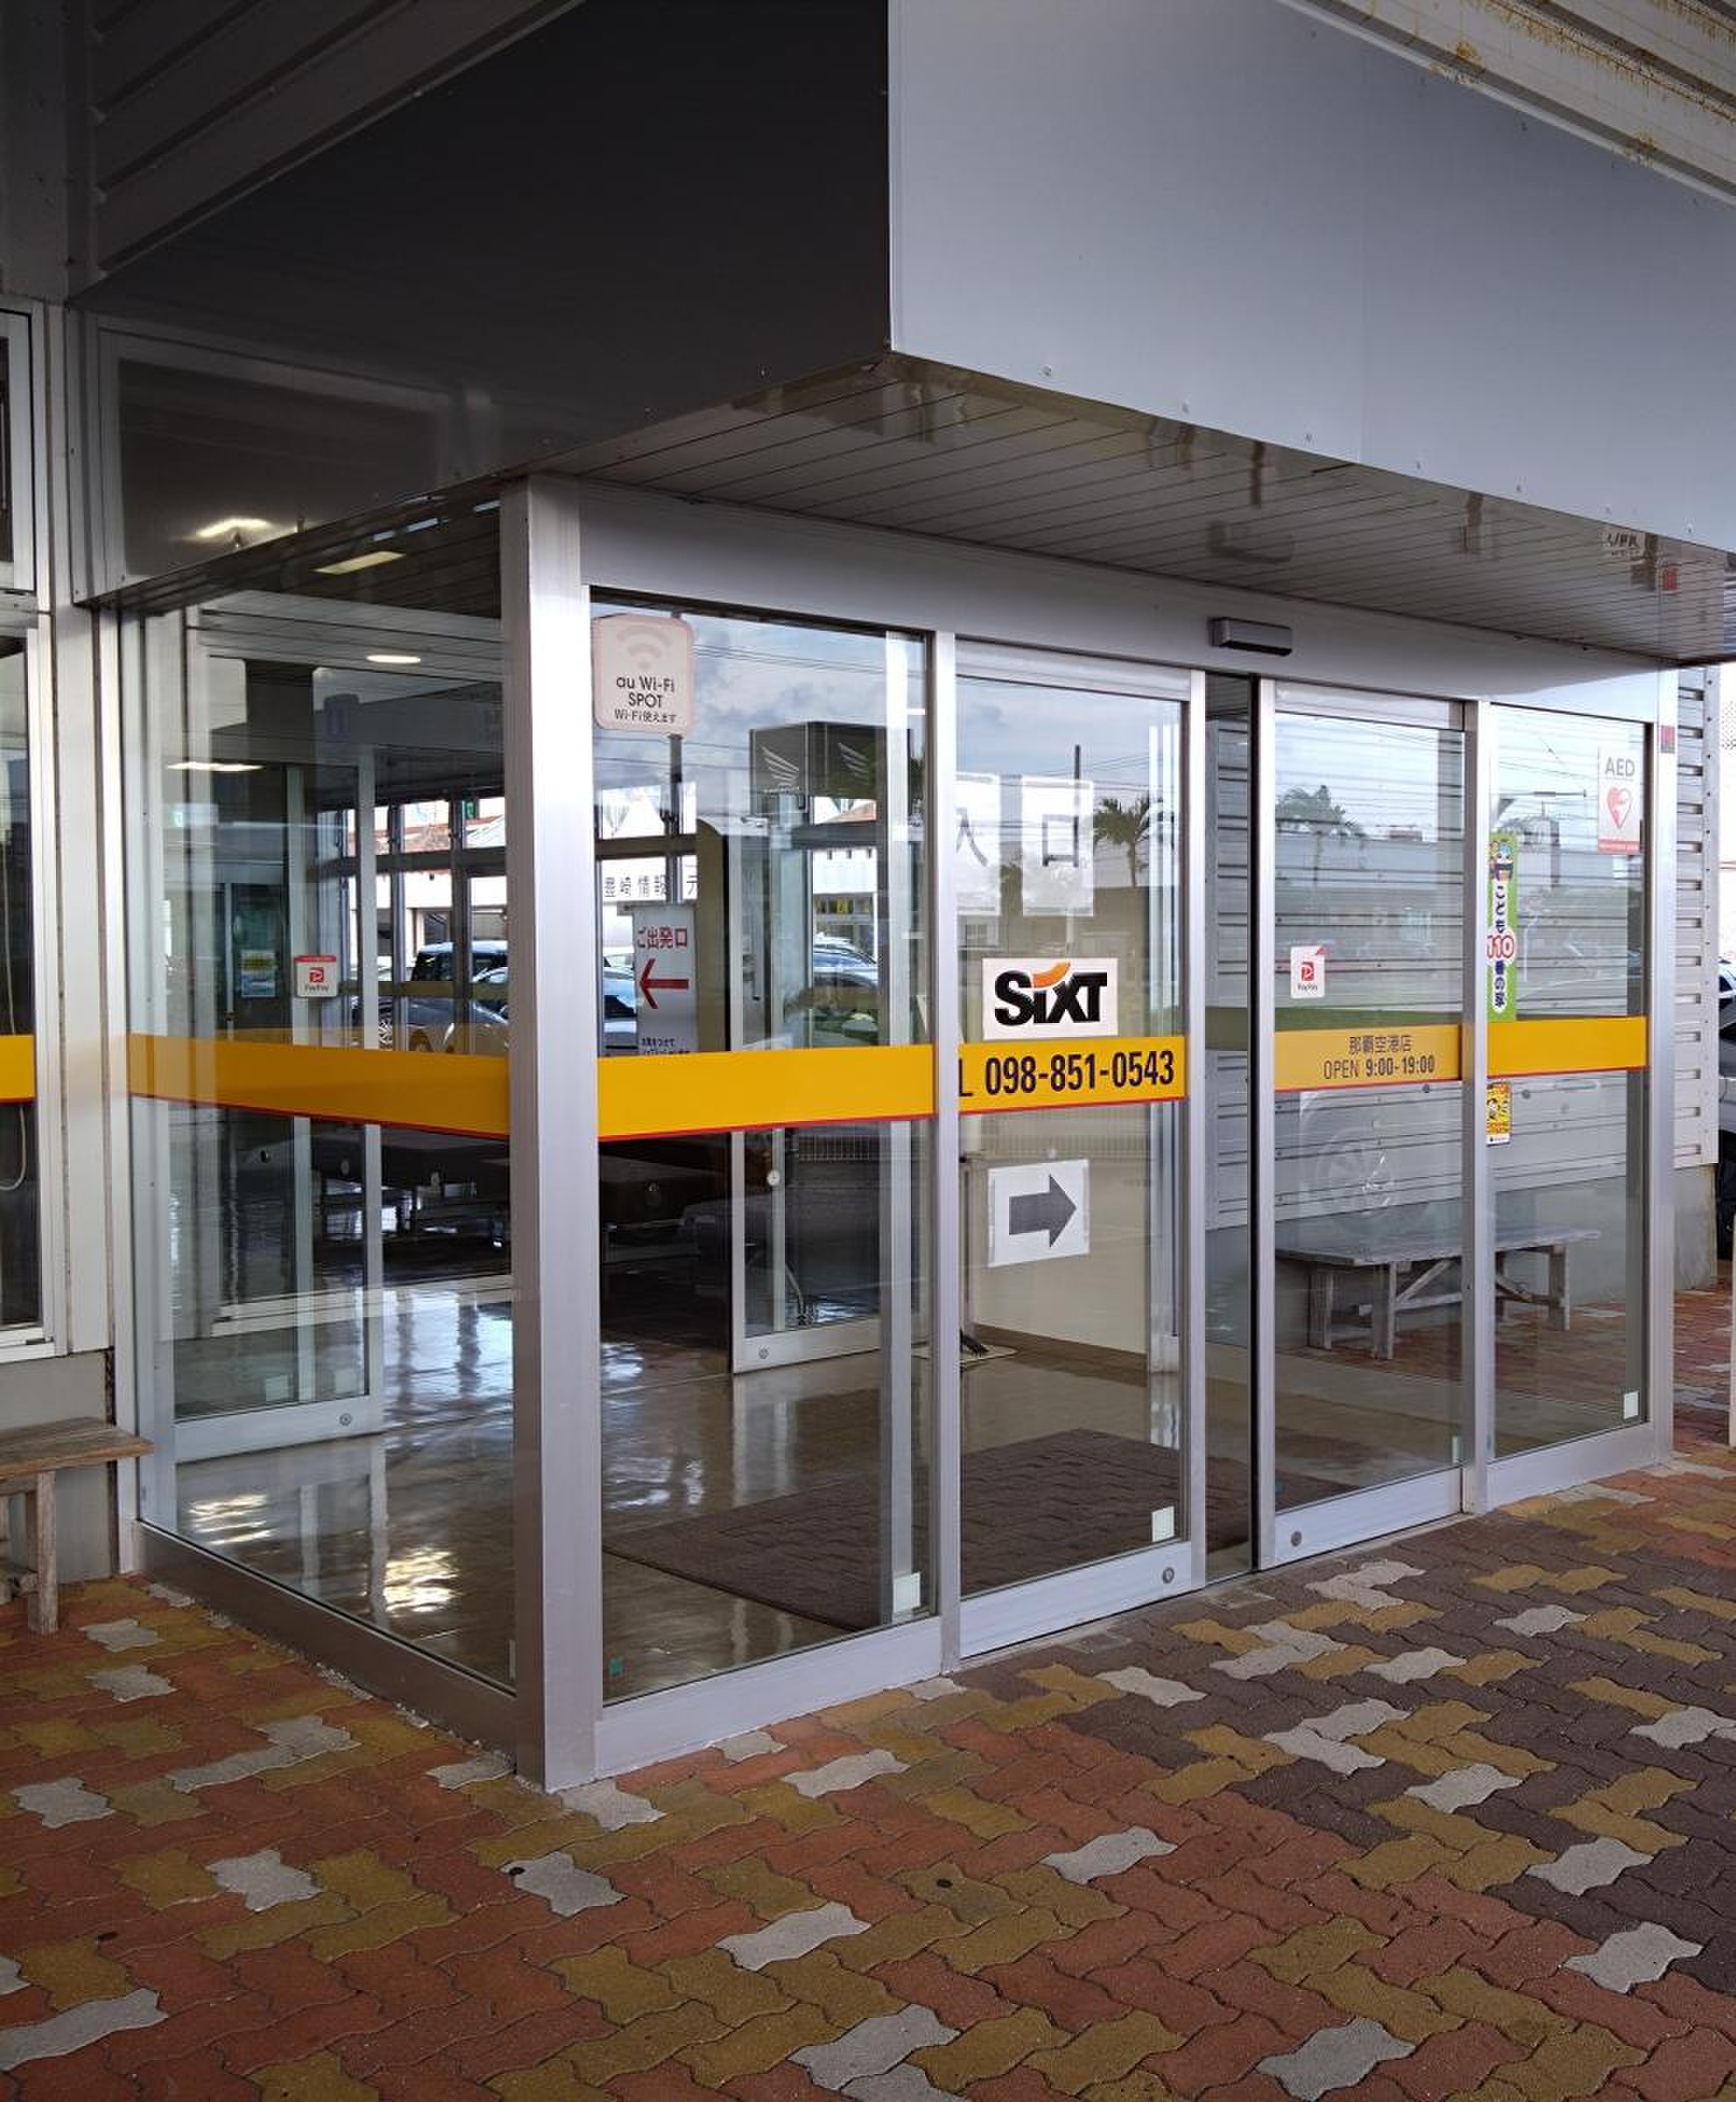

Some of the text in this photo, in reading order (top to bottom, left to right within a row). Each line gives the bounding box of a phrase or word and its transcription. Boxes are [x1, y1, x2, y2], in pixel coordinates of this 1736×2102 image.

[616, 675, 674, 692] au Wi-Fi
[628, 692, 663, 708] SPOT
[1605, 757, 1635, 778] AED
[637, 926, 688, 949] ご出発口
[1349, 1035, 1412, 1055] 那覇空港店
[985, 1050, 1175, 1095] 098-851-0543
[1323, 1060, 1358, 1079] OPEN
